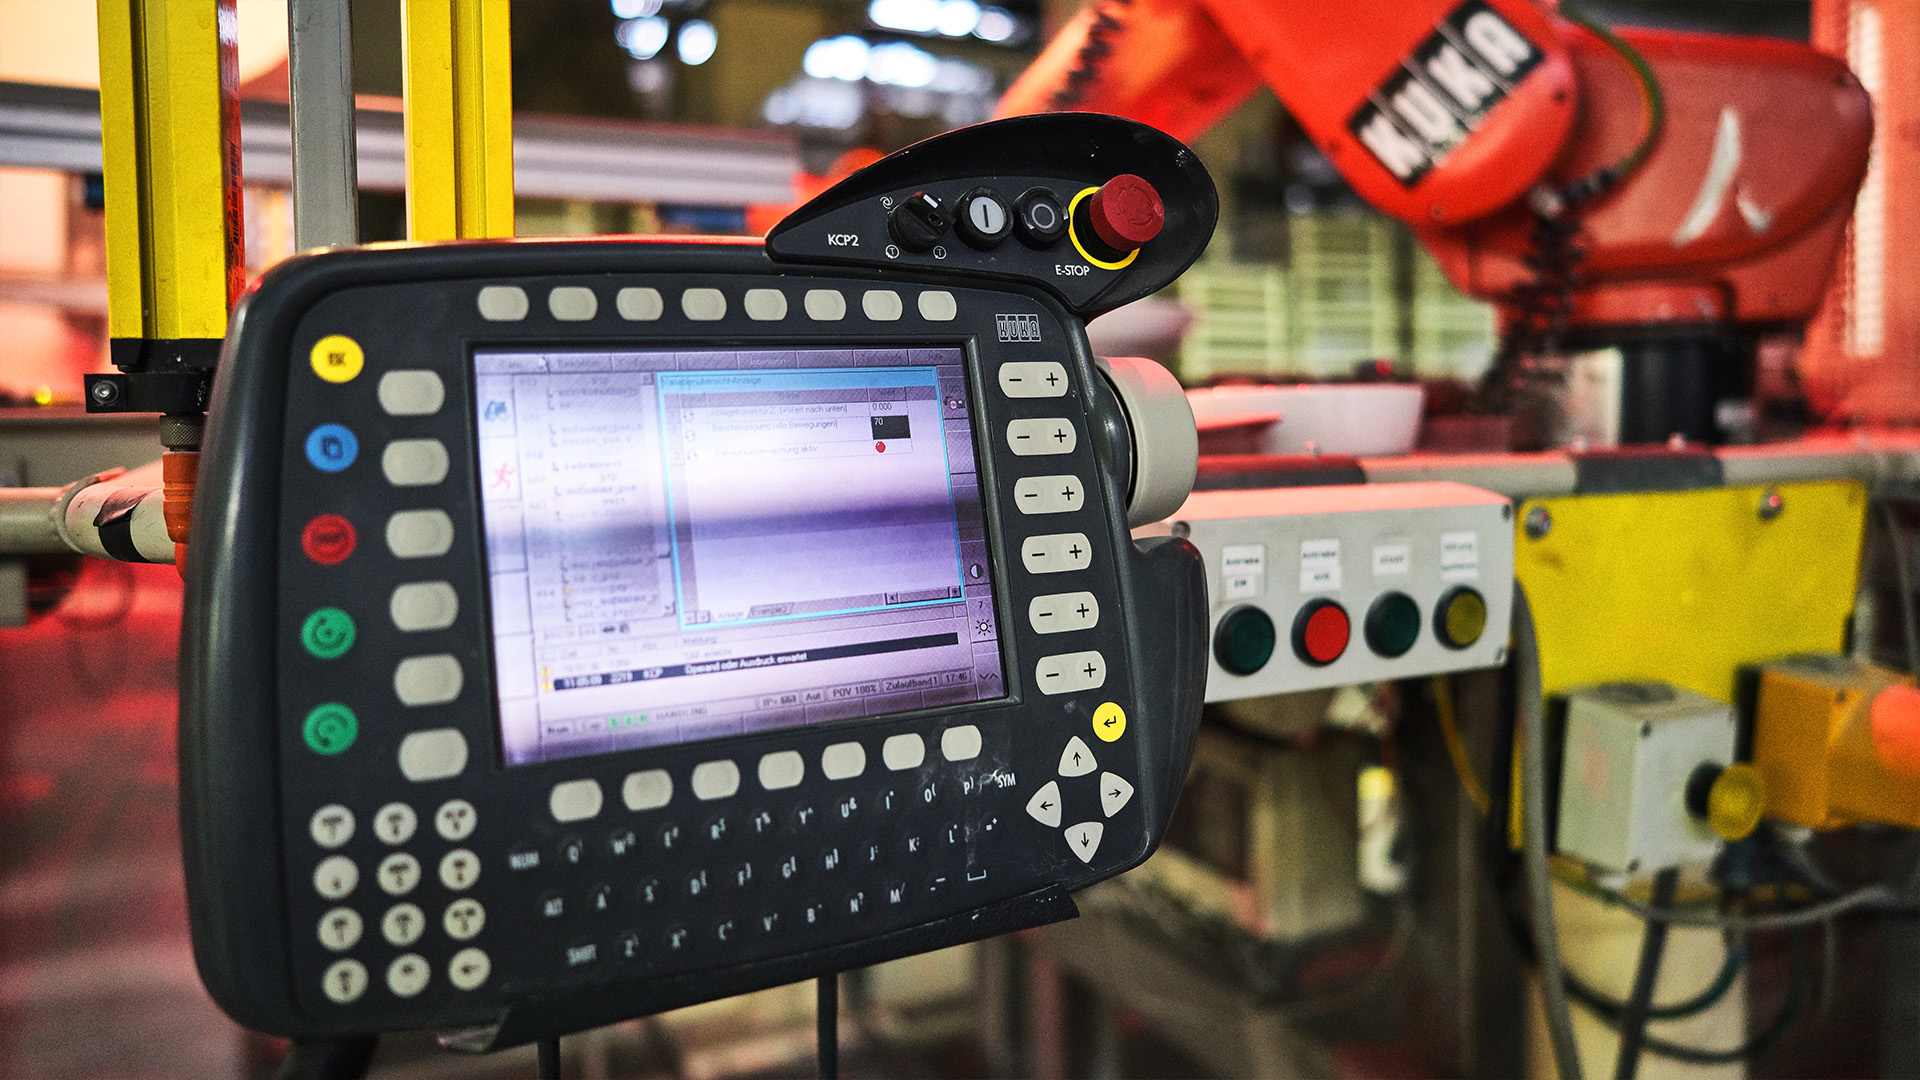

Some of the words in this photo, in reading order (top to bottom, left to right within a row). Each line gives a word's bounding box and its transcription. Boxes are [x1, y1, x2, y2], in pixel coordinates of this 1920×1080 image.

[1360, 10, 1532, 178] KUKA
[827, 233, 860, 248] KCP2
[1055, 264, 1090, 277] E-STOP
[997, 317, 1040, 340] KUKA
[805, 405, 825, 413] nach
[873, 417, 884, 426] 70
[977, 600, 984, 609] 7
[685, 661, 720, 676] Operand
[721, 659, 739, 671] oder
[945, 671, 968, 683] 17:46
[806, 692, 821, 701] Aut
[832, 686, 852, 698] POV
[855, 683, 877, 695] 100%
[998, 772, 1017, 788] SYM
